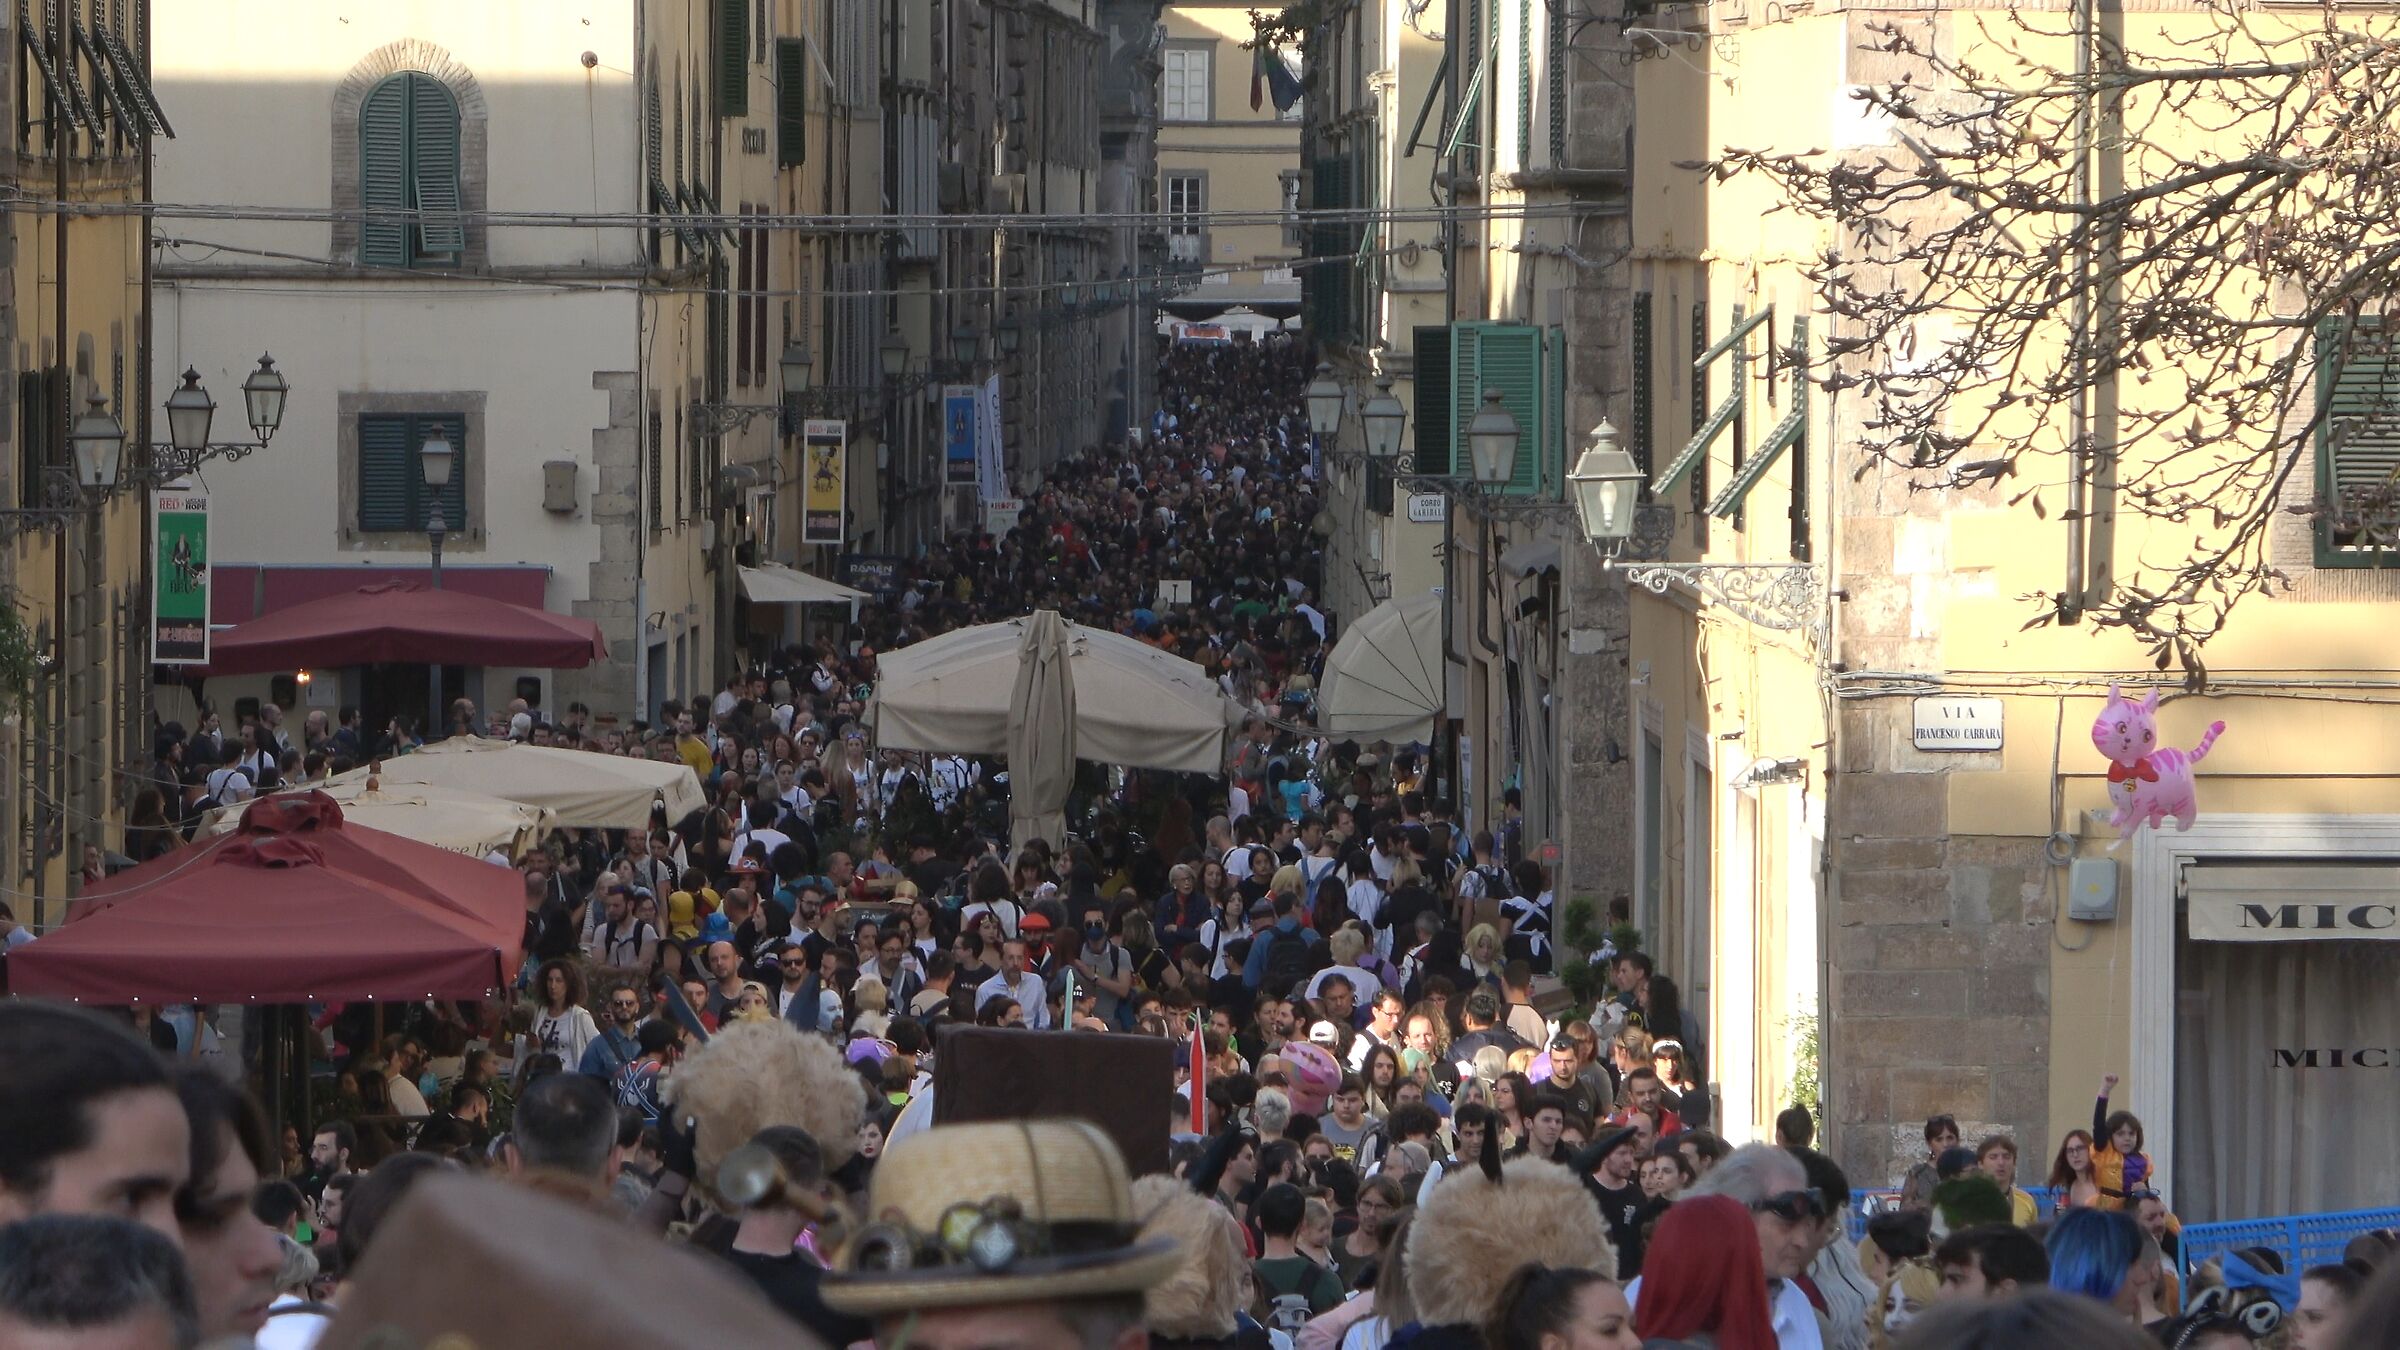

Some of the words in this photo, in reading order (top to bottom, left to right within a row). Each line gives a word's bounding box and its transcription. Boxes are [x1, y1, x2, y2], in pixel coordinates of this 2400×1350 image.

[159, 500, 180, 510] RED
[185, 503, 207, 511] HOPE
[1421, 499, 1441, 507] CORSO
[1413, 508, 1444, 517] GARIBAL
[1942, 706, 1975, 718] VIA
[1915, 728, 1960, 740] FRANCESCO
[1963, 728, 2001, 740] CARRARA
[2235, 903, 2396, 929] MIC
[2271, 1048, 2400, 1068] MIC
